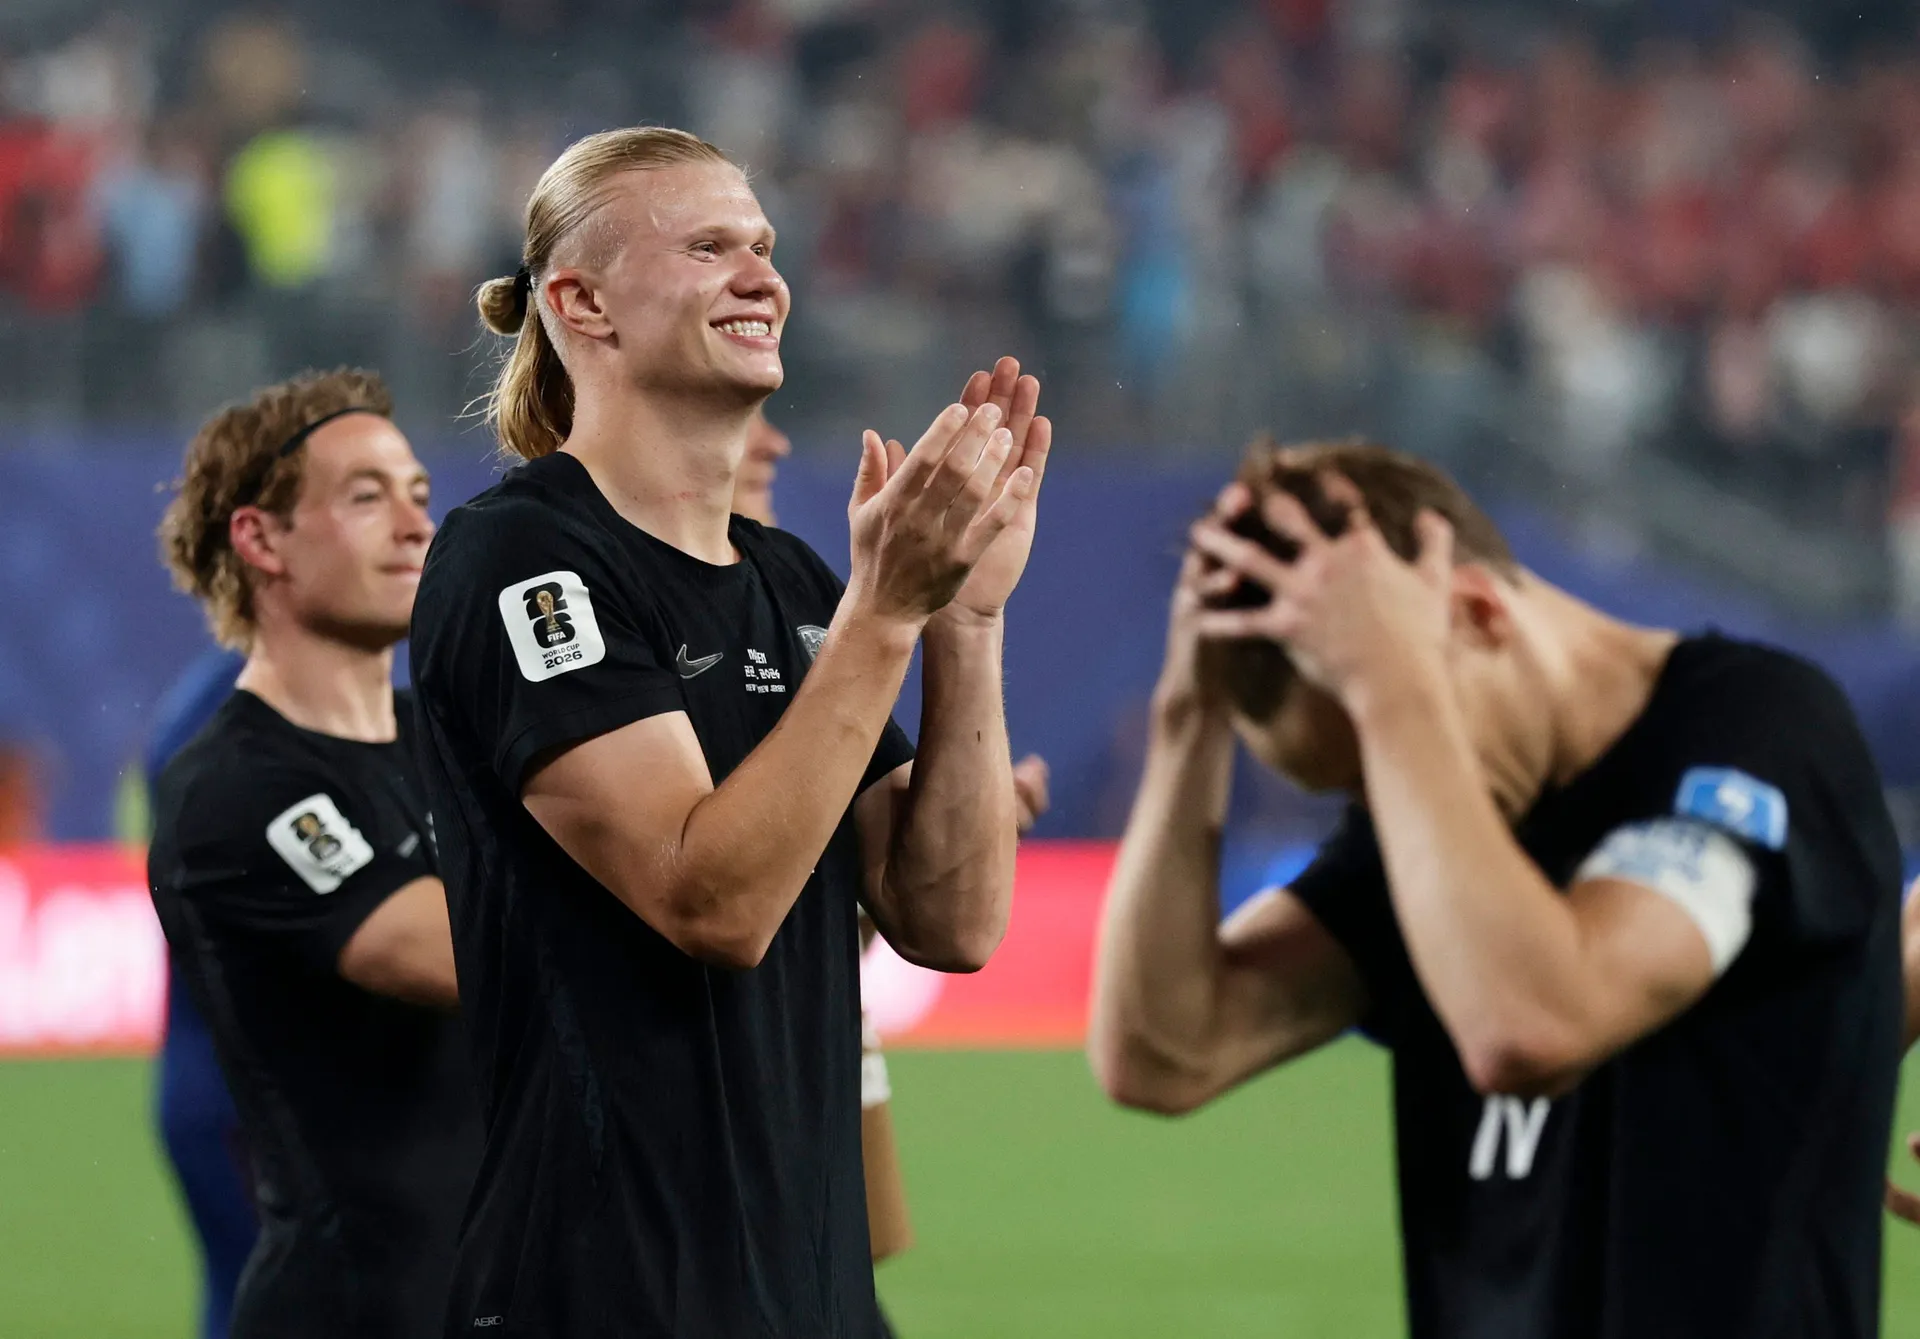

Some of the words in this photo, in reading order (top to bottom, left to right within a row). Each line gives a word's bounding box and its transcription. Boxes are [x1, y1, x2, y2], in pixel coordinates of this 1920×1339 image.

[547, 632, 566, 642] FIFA
[542, 647, 566, 659] WORLD
[566, 643, 581, 652] CUP
[545, 651, 583, 669] 2026
[474, 1316, 503, 1328] AERO
